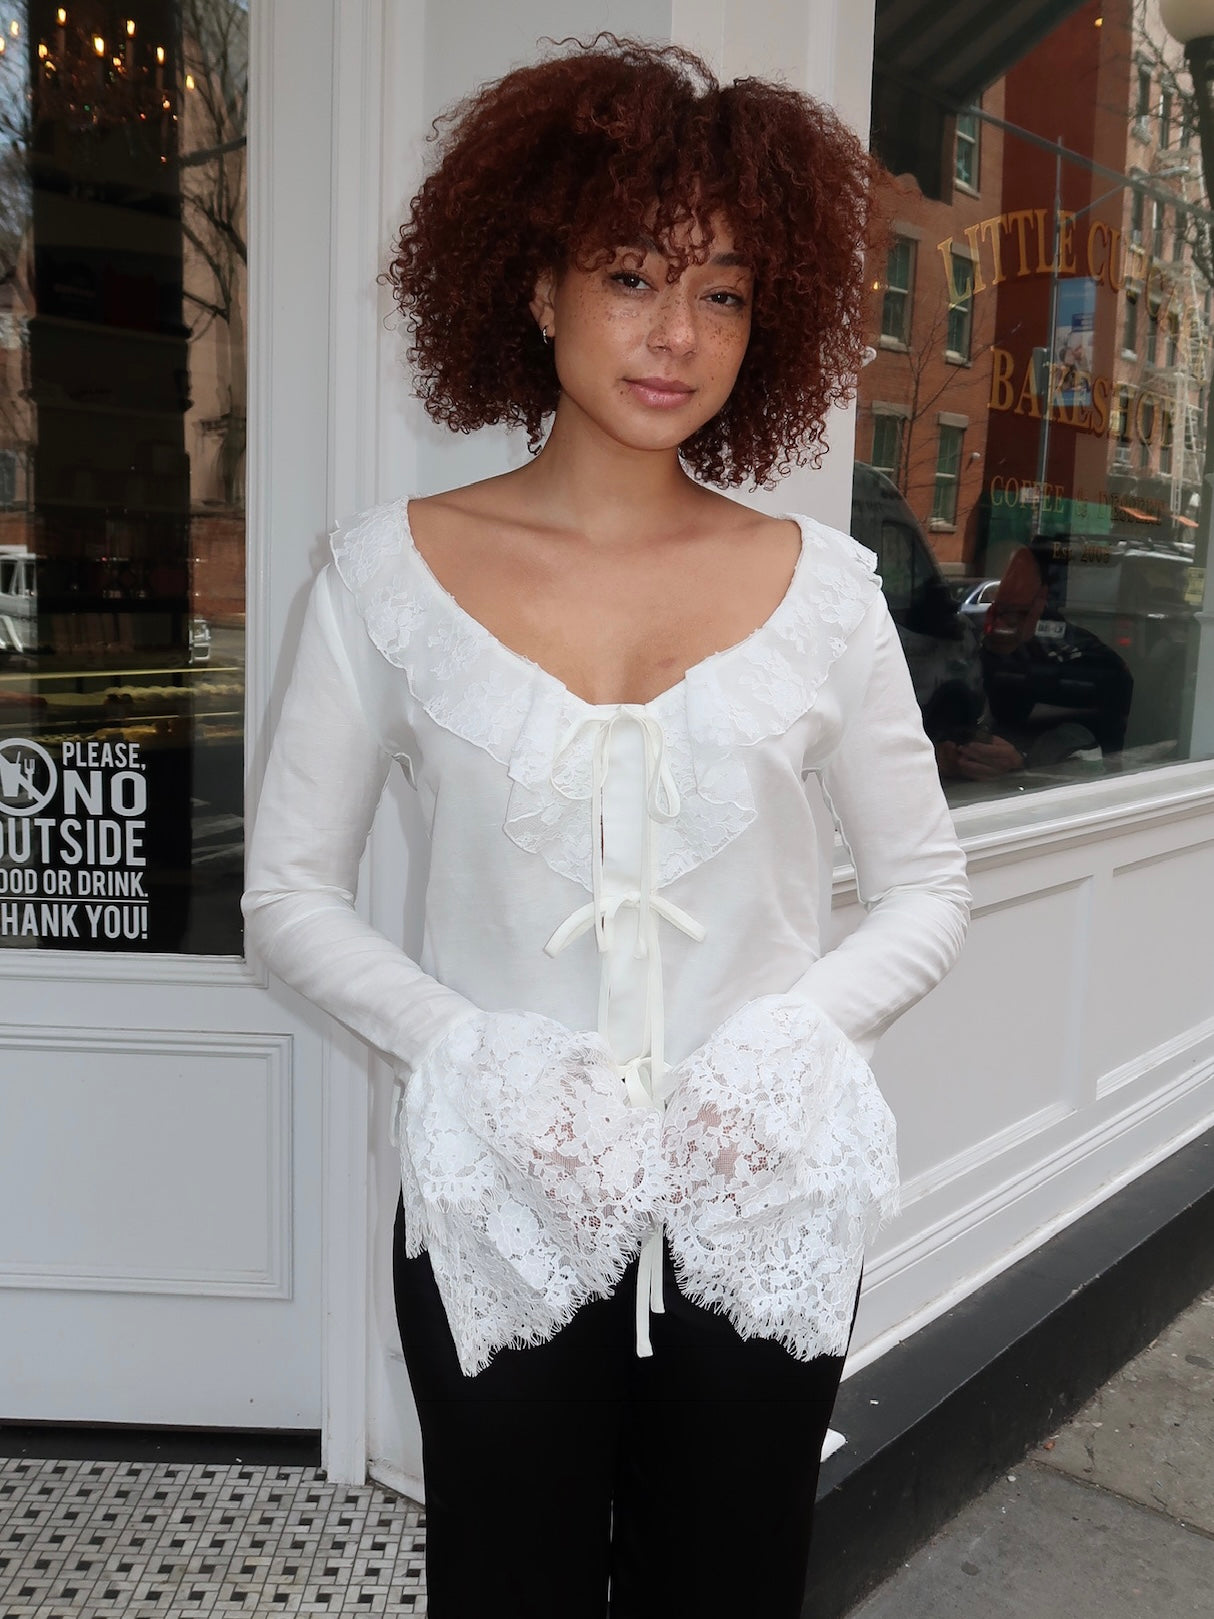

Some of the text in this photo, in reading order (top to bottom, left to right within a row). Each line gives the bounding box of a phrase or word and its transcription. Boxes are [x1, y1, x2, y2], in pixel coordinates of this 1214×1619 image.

[937, 208, 1077, 306] LITTLE
[990, 475, 1065, 513] COFFEE
[62, 741, 146, 770] PLEASE,
[63, 770, 147, 816] NO
[0, 817, 146, 866] UTSIDE
[0, 868, 149, 898] OOD OR DRINK.
[0, 902, 148, 940] HANK YOU!
